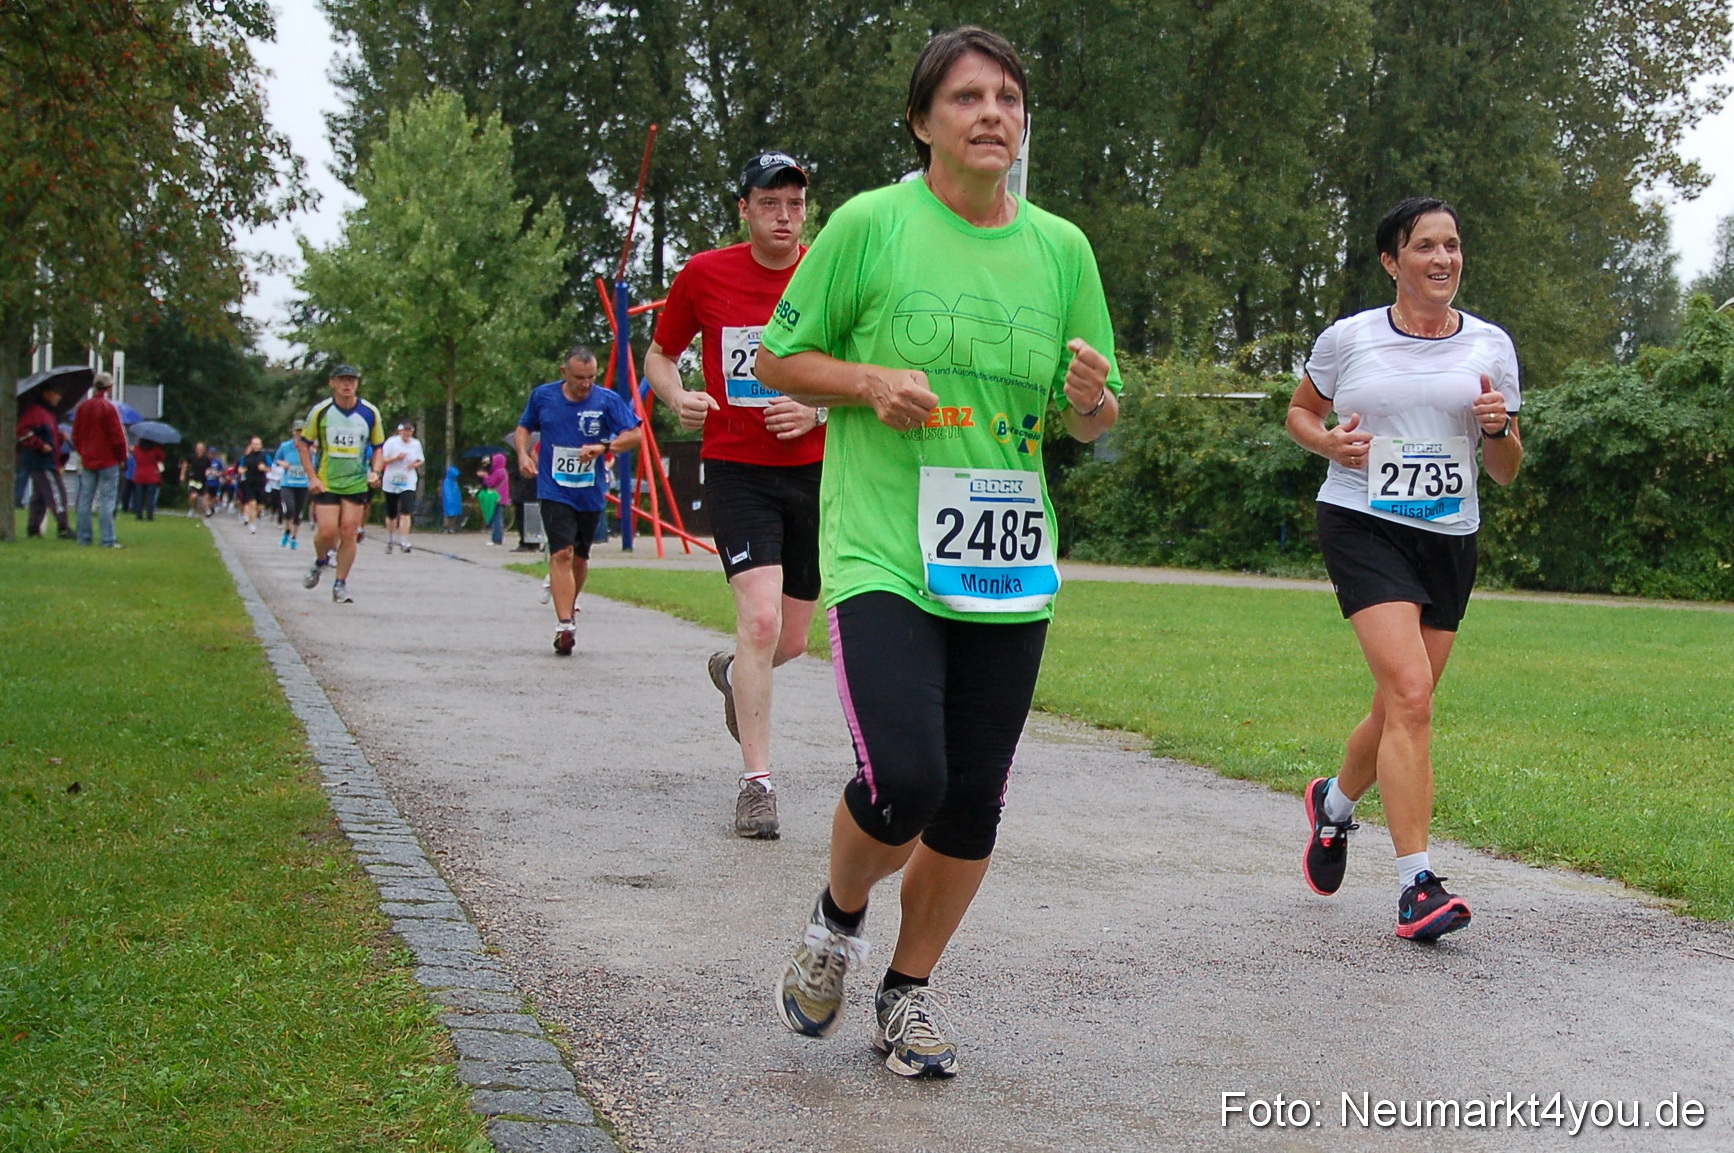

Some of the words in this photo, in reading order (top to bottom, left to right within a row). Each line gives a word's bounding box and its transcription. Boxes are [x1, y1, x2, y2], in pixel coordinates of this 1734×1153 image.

[969, 478, 1023, 494] BOCK
[1380, 462, 1463, 497] 2735
[936, 507, 1044, 562] 2485
[960, 572, 1024, 595] Monika
